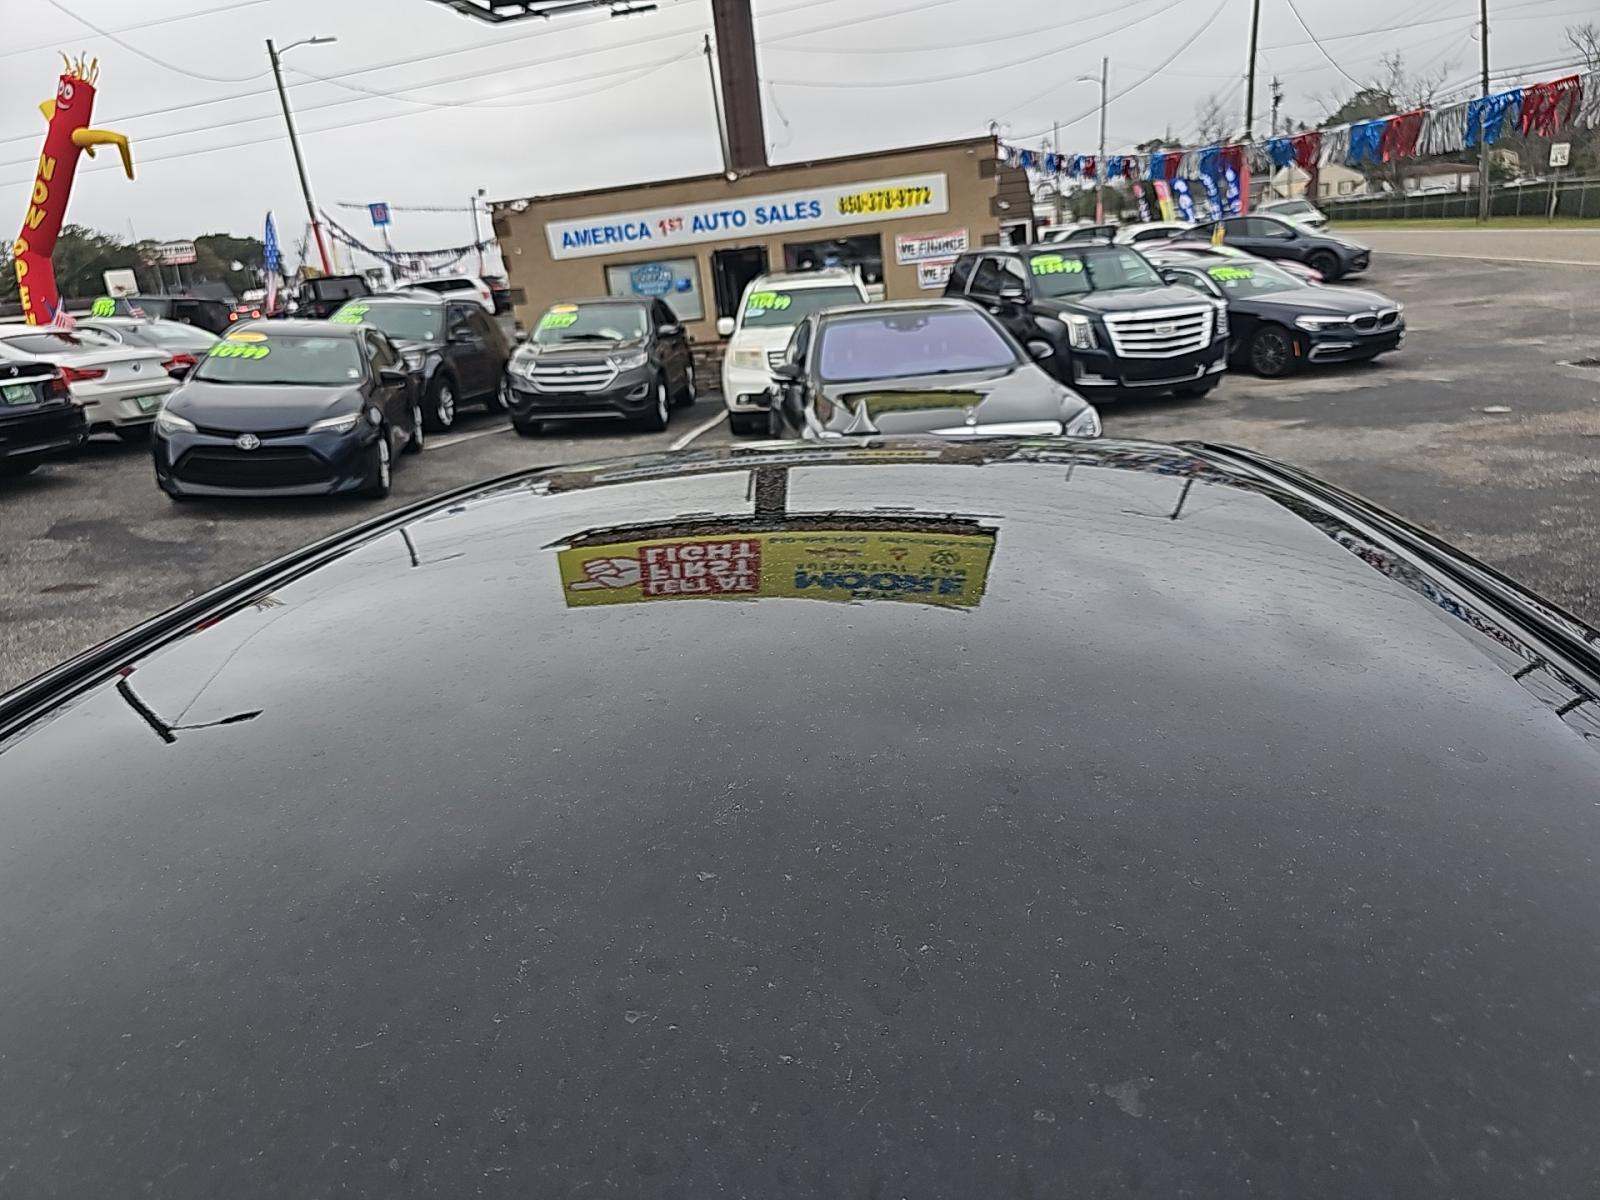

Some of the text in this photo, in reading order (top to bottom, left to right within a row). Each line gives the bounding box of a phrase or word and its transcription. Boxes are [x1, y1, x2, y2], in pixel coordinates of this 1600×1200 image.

[562, 222, 652, 249] AMERICA
[658, 217, 684, 237] 1ST
[692, 210, 747, 233] AUTO
[755, 200, 823, 225] SALES
